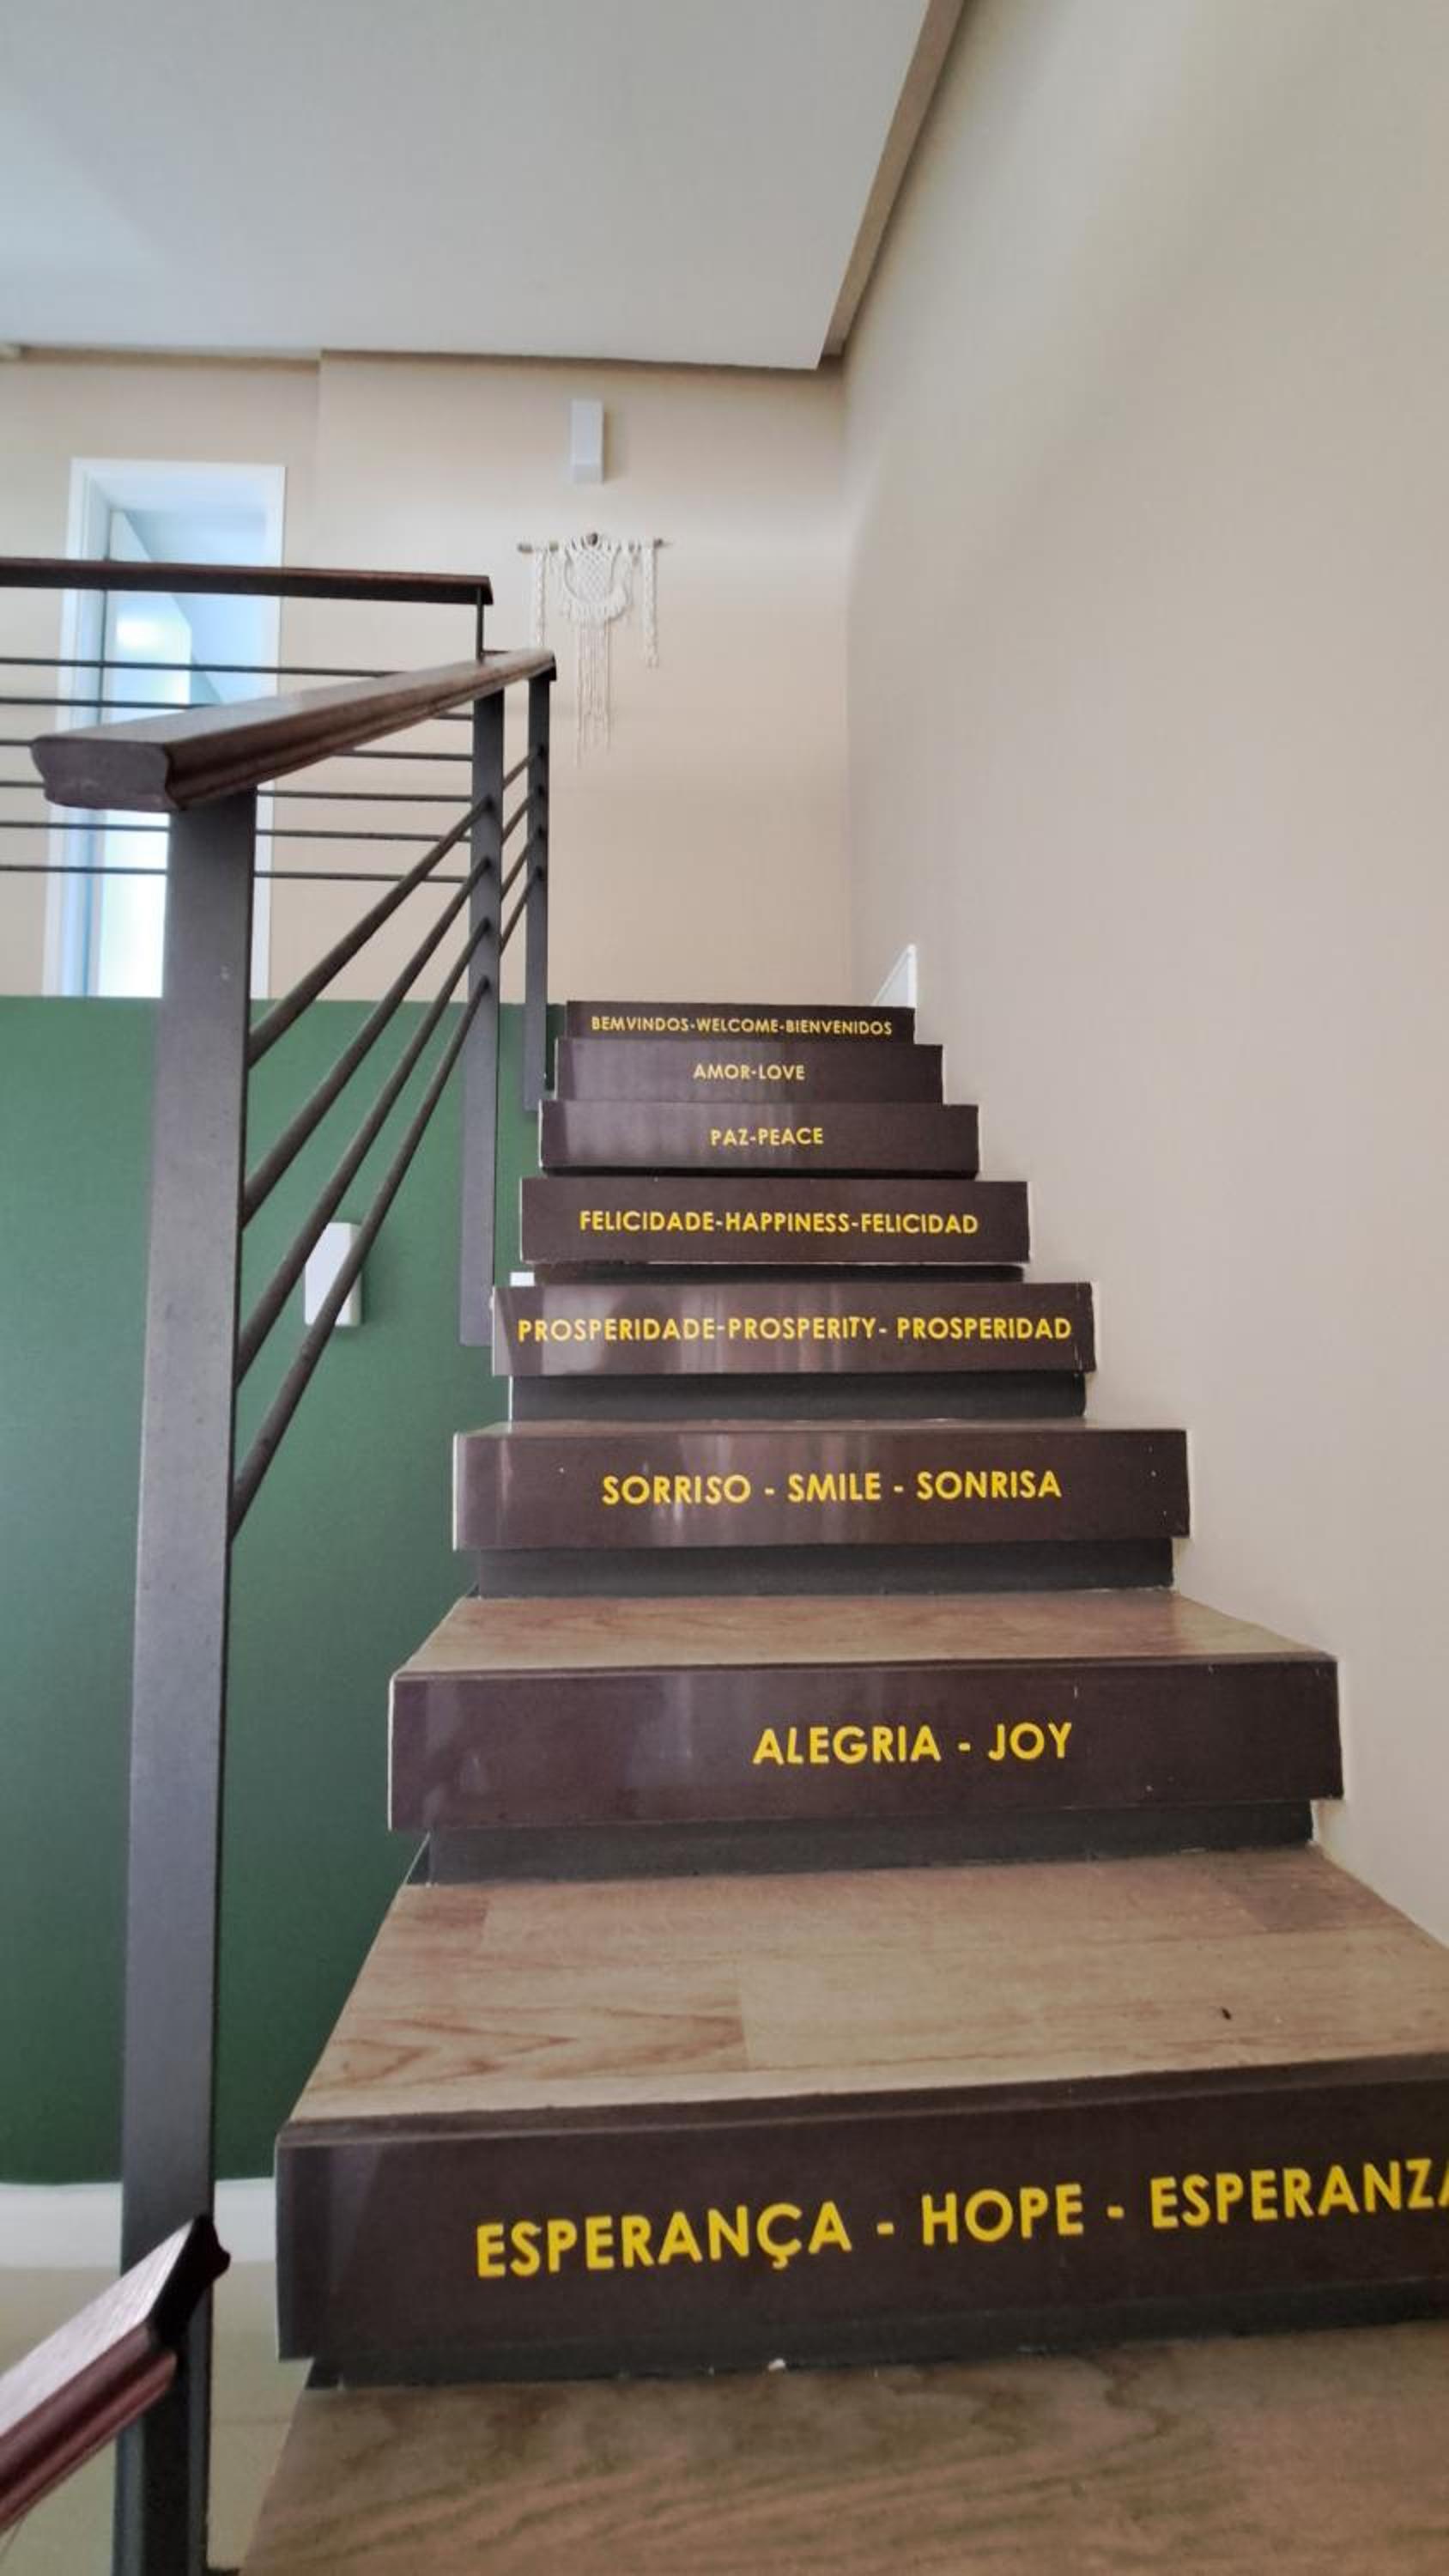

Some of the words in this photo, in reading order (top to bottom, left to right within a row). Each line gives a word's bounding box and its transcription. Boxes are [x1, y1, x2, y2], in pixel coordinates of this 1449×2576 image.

[590, 1015, 893, 1036] BEMVINDOS-WELCOME-BIENVENIDOS
[693, 1064, 806, 1081] AMOR-LOVE
[710, 1127, 824, 1147] PAZ-PEACE
[579, 1209, 979, 1235] FELICIDADE-HAPPINESS-FELICIDAD
[895, 1317, 1071, 1342] PROSPERIDAD
[602, 1474, 751, 1505] SORRISO
[787, 1470, 881, 1504] SMILE
[915, 1468, 1062, 1503] SONRISA
[752, 1724, 940, 1766] ALEGRIA
[988, 1721, 1073, 1761] JOY
[476, 2200, 852, 2279] ESPERANÇA
[920, 2182, 1084, 2248] HOPE
[1149, 2157, 1449, 2230] ESPERANZ
